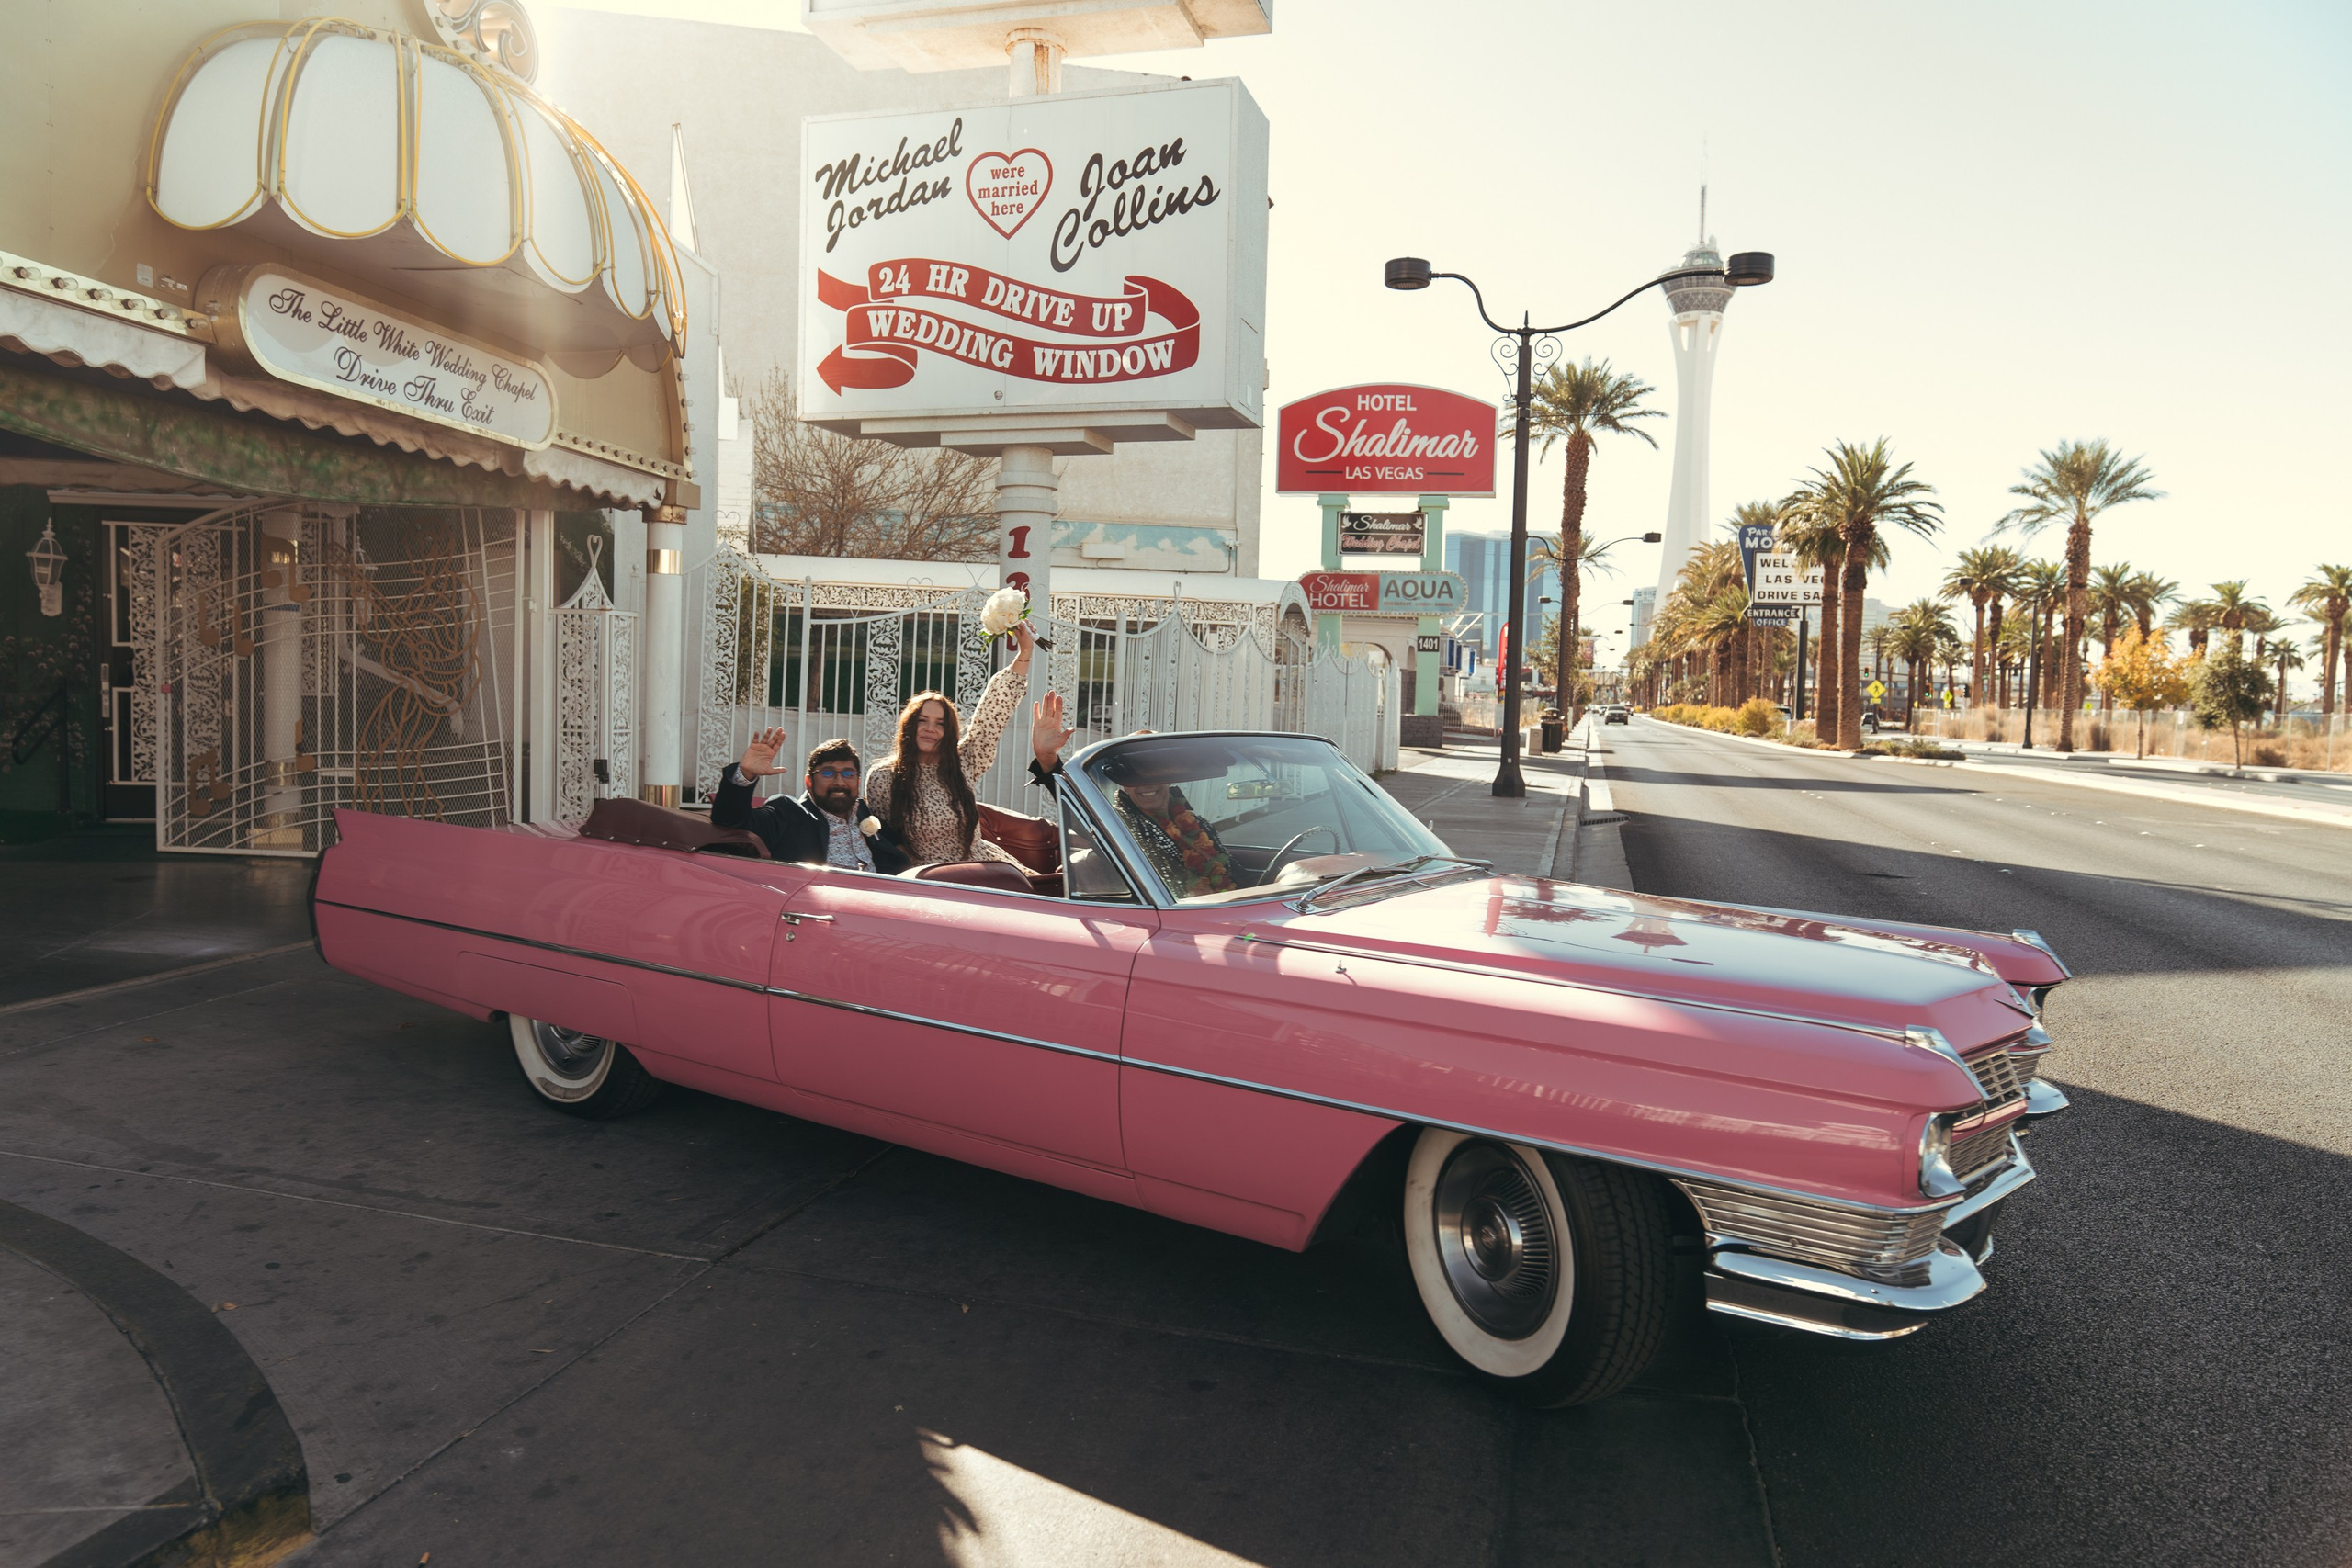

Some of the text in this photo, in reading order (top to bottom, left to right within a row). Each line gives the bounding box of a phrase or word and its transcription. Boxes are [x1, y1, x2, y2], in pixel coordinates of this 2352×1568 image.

[815, 117, 963, 200] Michael
[990, 166, 1025, 180] were
[1080, 137, 1187, 222] Joan
[978, 180, 1038, 199] married
[826, 176, 952, 254] Jordan
[990, 201, 1024, 216] here
[1050, 175, 1221, 273] Collins
[878, 264, 1133, 332] 24 HR DRIVE UP
[269, 288, 538, 403] The Little White Wedding Chapel
[866, 310, 1175, 378] WEDDING WINDOW
[334, 346, 496, 424] Drive Thru Exit
[1357, 394, 1417, 411] HOTEL
[1294, 406, 1479, 463] Shalimar
[1345, 466, 1424, 480] LAS VEGAS
[1353, 515, 1411, 531] Shalimar
[1745, 536, 1773, 549] MO
[1309, 575, 1370, 593] Shalimar
[1765, 575, 1824, 584] LAS VE
[1385, 579, 1453, 600] AQUA
[1758, 591, 1820, 600] DRIVE SA
[1309, 593, 1370, 608] HOTEL
[1747, 609, 1797, 617] ENTRANCE
[1756, 618, 1786, 626] OFFICE
[1419, 638, 1439, 649] 1401
